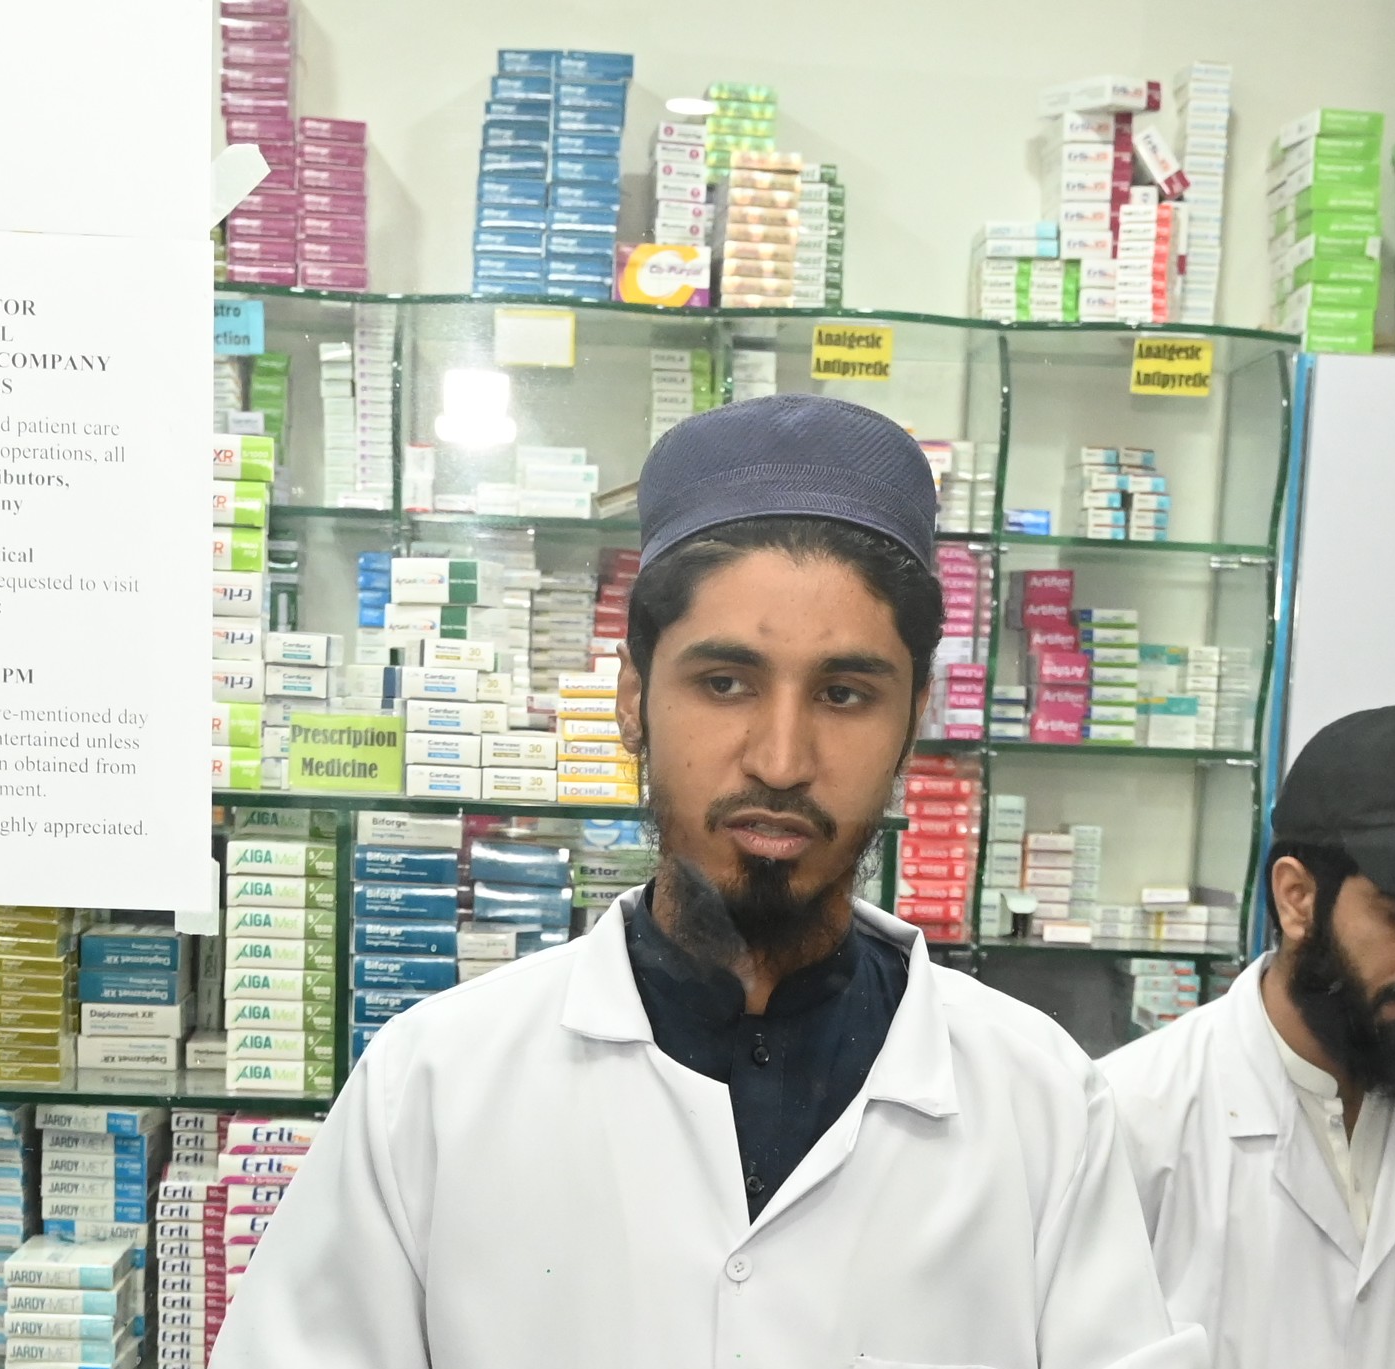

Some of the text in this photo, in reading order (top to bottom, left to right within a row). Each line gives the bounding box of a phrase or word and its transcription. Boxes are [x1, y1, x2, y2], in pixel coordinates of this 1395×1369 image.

[814, 328, 882, 350] Analgesic
[1135, 341, 1202, 361] Analgesic
[814, 356, 890, 378] Antipyretic
[1134, 369, 1210, 389] Antipyretic
[16, 415, 77, 438] patient
[82, 423, 120, 437] care
[0, 442, 98, 464] operations,
[103, 445, 125, 463] all
[79, 577, 97, 591] to
[102, 575, 139, 593] visit
[2, 666, 33, 685] PM
[117, 707, 146, 730] day
[85, 732, 140, 750] unless
[291, 724, 397, 748] Prescription
[528, 743, 543, 753] 30
[13, 754, 89, 774] obtained
[95, 756, 137, 775] from
[301, 757, 379, 779] Medicine
[42, 817, 148, 839] appreciated.
